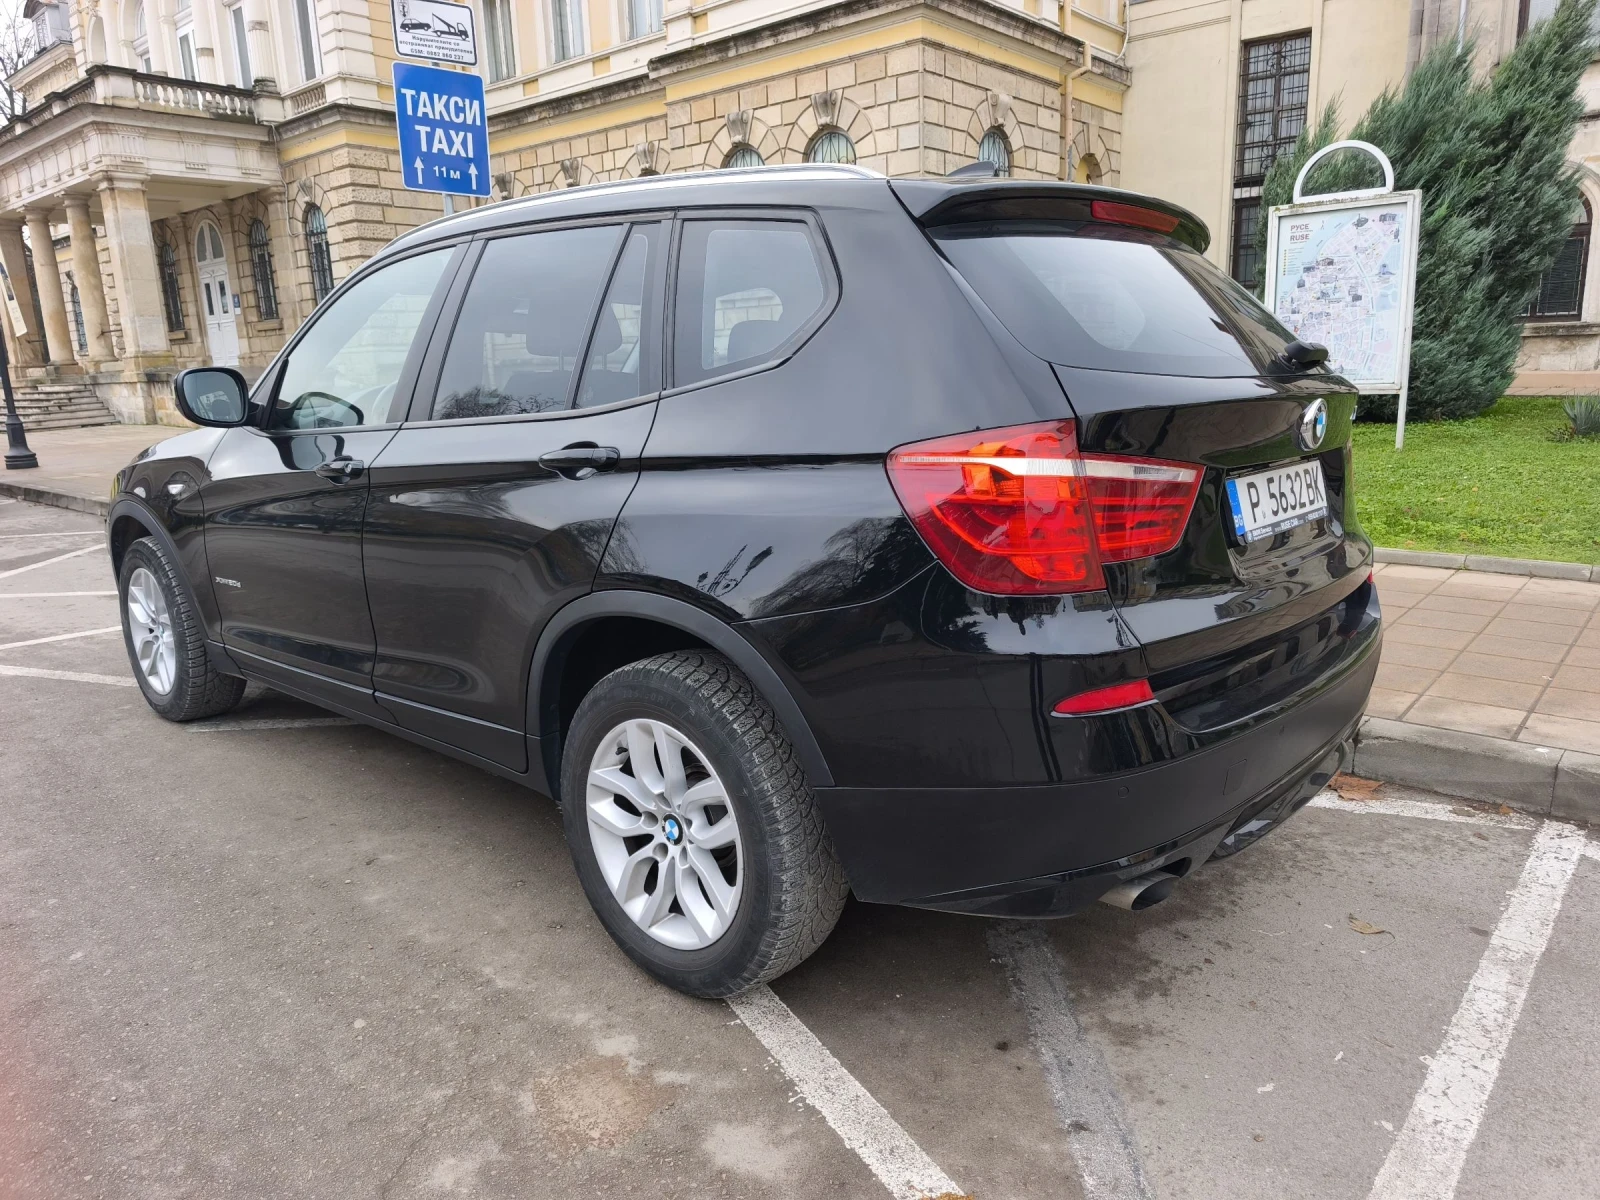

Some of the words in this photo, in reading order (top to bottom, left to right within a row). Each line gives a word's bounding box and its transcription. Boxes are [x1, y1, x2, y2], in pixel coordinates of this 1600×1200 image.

[400, 87, 481, 127] ТАКСИ
[414, 124, 474, 159] TAXI
[433, 165, 447, 178] 11
[1290, 223, 1310, 232] РУСЕ
[1289, 233, 1310, 242] RUSE
[1233, 514, 1244, 528] BG
